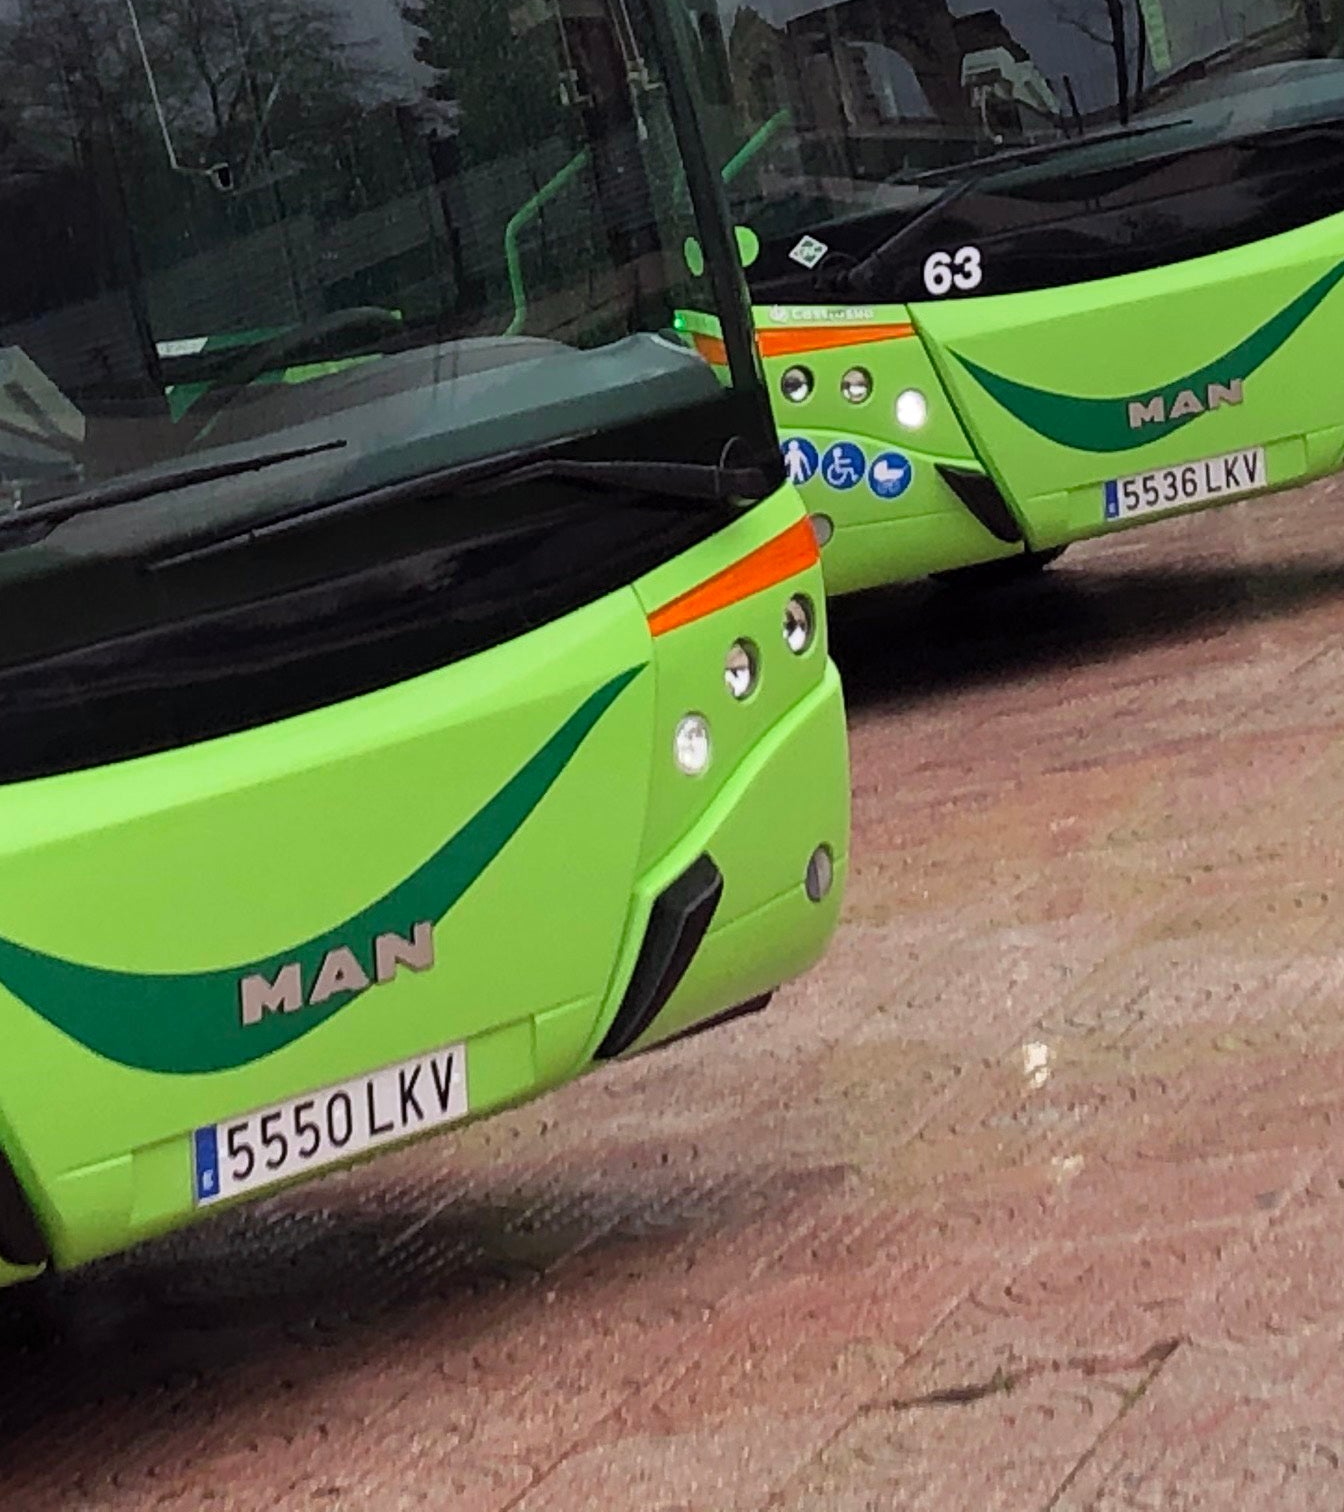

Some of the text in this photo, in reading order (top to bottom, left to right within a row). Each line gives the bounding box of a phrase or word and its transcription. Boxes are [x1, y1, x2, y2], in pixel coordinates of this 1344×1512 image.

[923, 246, 982, 295] 63
[1127, 378, 1244, 430] MAN
[1121, 451, 1258, 513] 5536 LKV
[239, 921, 435, 1027] MAN
[226, 1090, 353, 1181] 5550
[366, 1052, 455, 1137] LKV
